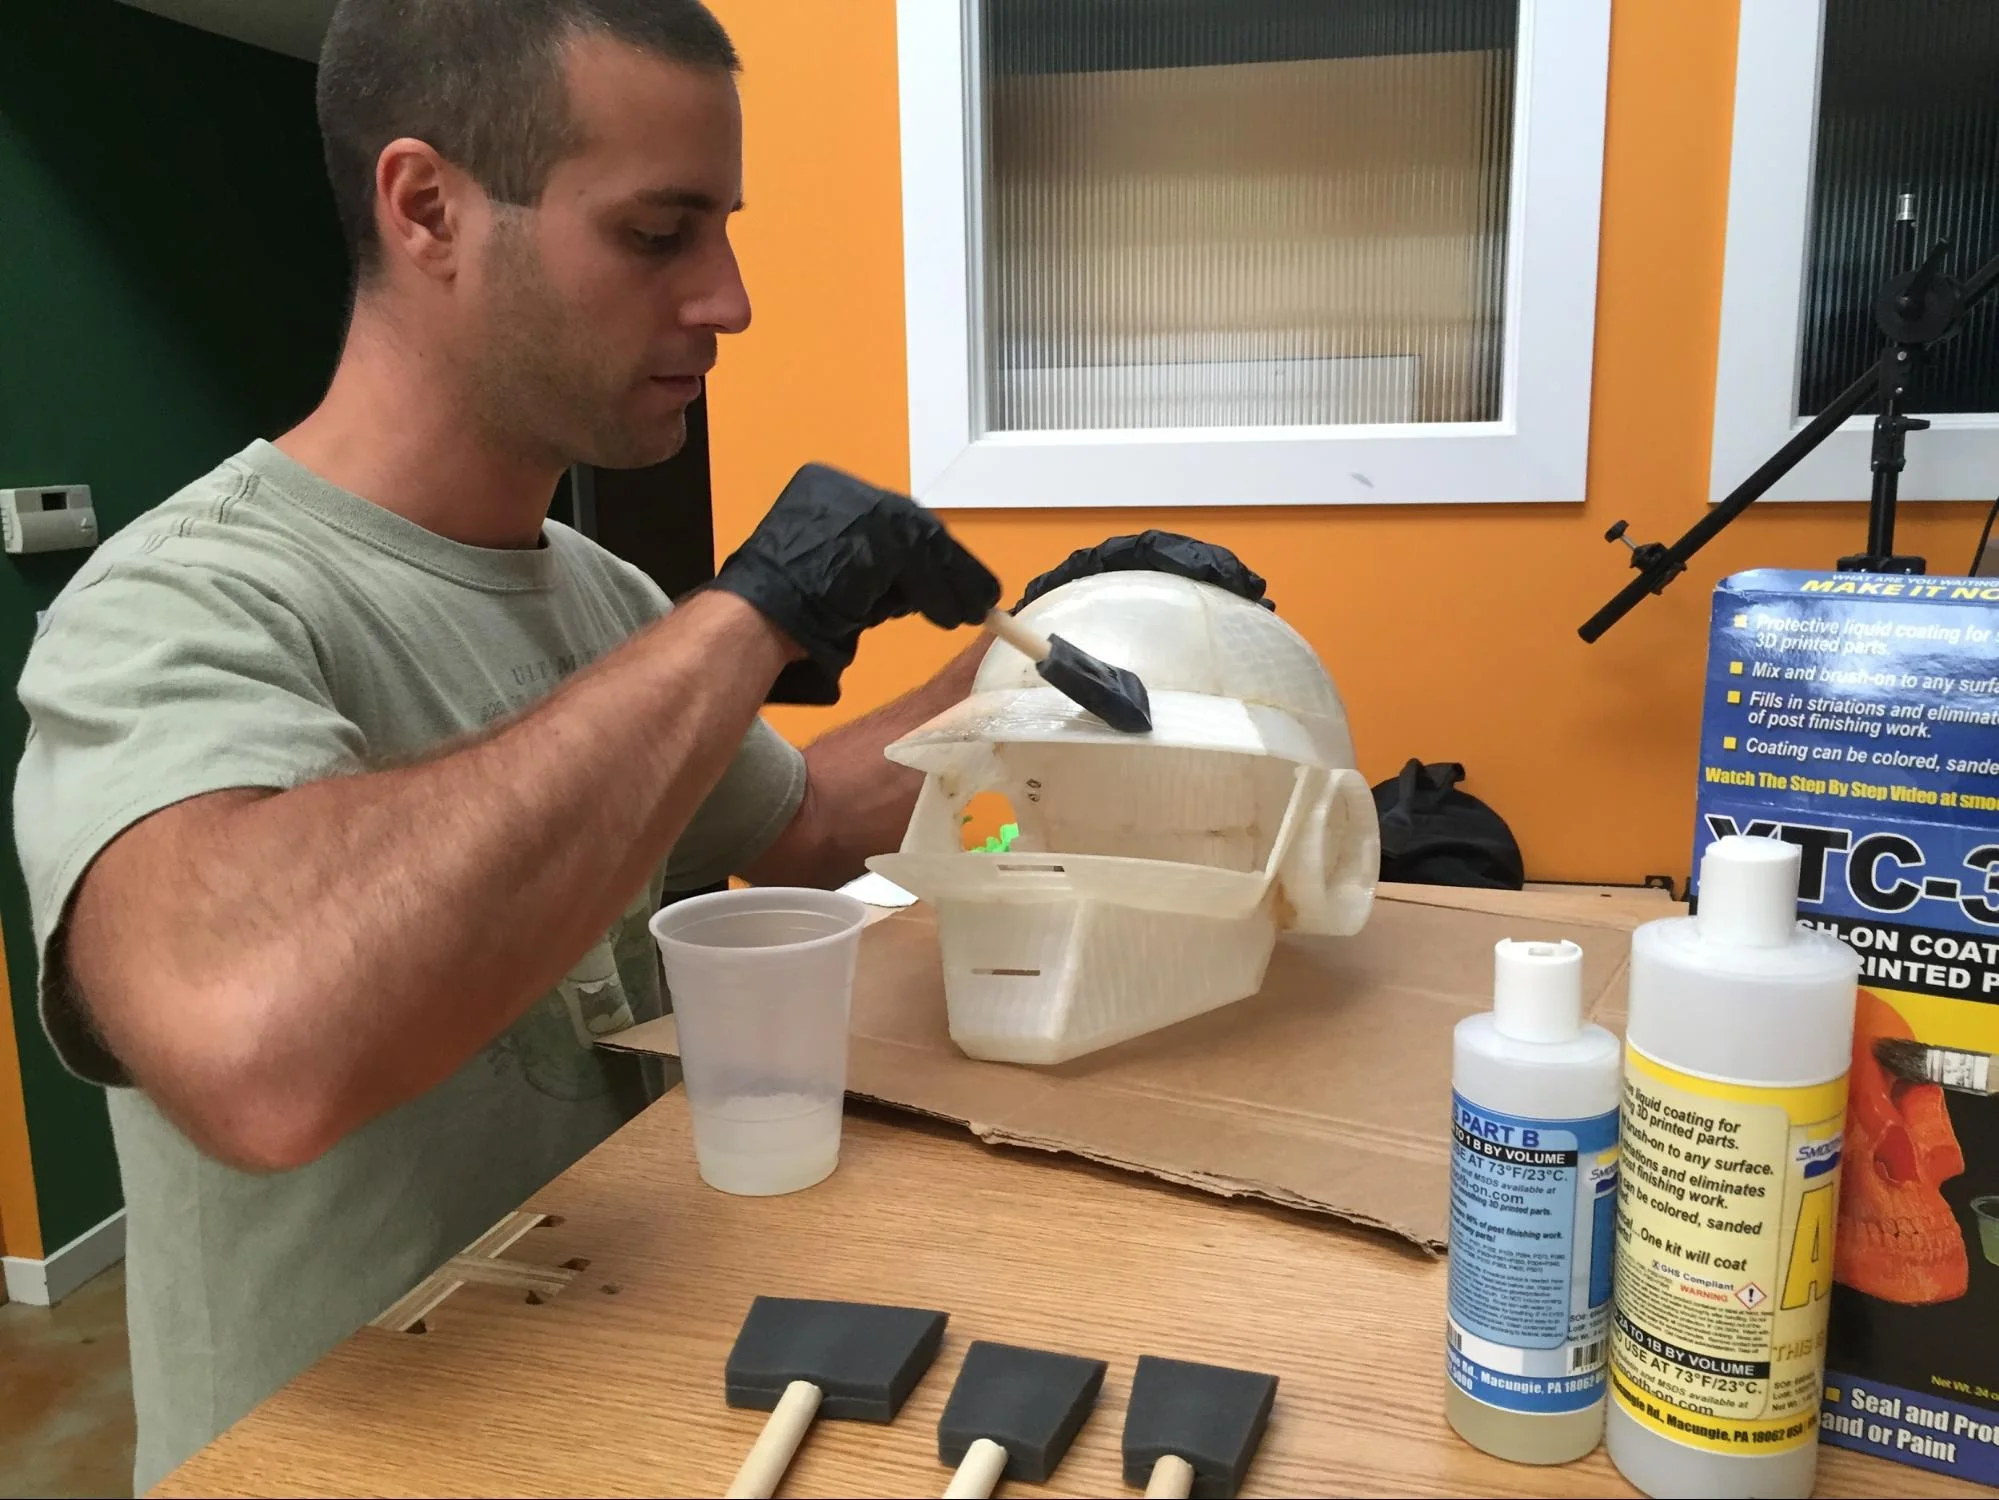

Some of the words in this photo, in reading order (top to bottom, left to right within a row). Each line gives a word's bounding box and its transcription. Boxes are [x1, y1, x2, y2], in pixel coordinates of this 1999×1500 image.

[1800, 580, 1904, 595] MAKE
[1910, 585, 1946, 598] IT
[1755, 614, 1838, 634] Protective
[1844, 620, 1892, 638] liquid
[1895, 625, 1960, 644] coating
[1966, 625, 1989, 642] for
[1755, 632, 1776, 648] 3D
[1781, 634, 1840, 653] printed
[1843, 641, 1890, 655] parts.
[1752, 661, 1781, 679] Mix
[1785, 664, 1815, 681] and
[1820, 669, 1896, 687] brush-on
[1901, 672, 1918, 688] to
[1922, 675, 1954, 694] any
[1749, 690, 1783, 708] Fills
[1787, 692, 1802, 709] in
[1808, 695, 1885, 716] striations
[1891, 700, 1923, 719] and
[1748, 710, 1766, 725] of
[1768, 712, 1804, 729] post
[1809, 715, 1881, 737] finishing
[1886, 722, 1932, 739] work.
[1746, 737, 1809, 762] Coating
[1813, 746, 1842, 761] can
[1847, 747, 1867, 763] be
[1872, 750, 1941, 771] colored,
[1706, 767, 1755, 787] Watch
[1759, 772, 1787, 789] The
[1790, 775, 1825, 795] Step
[1829, 779, 1849, 797] By
[1851, 782, 1887, 800] Step
[1891, 786, 1937, 805] Video
[1940, 790, 1957, 807] at
[1910, 935, 1999, 965] COAT
[1636, 1088, 1661, 1112] liquid
[1663, 1106, 1714, 1131] coating
[1718, 1119, 1741, 1133] for
[1462, 1109, 1515, 1144] PART
[1522, 1130, 1539, 1147] B
[1650, 1116, 1693, 1140] printed
[1696, 1131, 1739, 1150] parts.
[1466, 1136, 1470, 1145] 1
[1473, 1139, 1481, 1150] B
[1484, 1143, 1501, 1156] BY
[1506, 1150, 1565, 1164] VOLUME
[1468, 1154, 1484, 1168] AT
[1627, 1118, 1664, 1152] brush-on
[1668, 1144, 1680, 1158] to
[1684, 1152, 1711, 1169] any
[1715, 1156, 1774, 1176] surface.
[1474, 1172, 1499, 1187] MSDS
[1501, 1183, 1544, 1194] available
[1637, 1165, 1685, 1200] finishing
[1689, 1190, 1728, 1209] work.
[1662, 1168, 1685, 1182] and
[1689, 1174, 1766, 1198] eliminates
[1500, 1204, 1529, 1214] printed
[1530, 1208, 1552, 1216] parts.
[1624, 1178, 1635, 1195] can
[1637, 1187, 1648, 1204] be
[1650, 1197, 1701, 1227] colored,
[1707, 1217, 1763, 1235] sanded
[1487, 1225, 1504, 1234] post
[1506, 1228, 1541, 1240] finishing
[1665, 1240, 1683, 1257] kit
[1685, 1246, 1710, 1265] will
[1714, 1257, 1747, 1272] coat
[1680, 1284, 1728, 1302] WARNING
[1683, 1272, 1734, 1291] Compliant
[1625, 1338, 1647, 1364] USE
[1651, 1358, 1670, 1374] AT
[1630, 1325, 1643, 1342] TO
[1647, 1338, 1661, 1353] 1B
[1665, 1347, 1684, 1361] BY
[1689, 1355, 1755, 1376] VOLUME
[1481, 1371, 1543, 1394] Macungie,
[1548, 1381, 1561, 1393] PA
[1657, 1380, 1686, 1395] MSDS
[1689, 1393, 1735, 1408] available
[1739, 1401, 1749, 1409] at
[1851, 1387, 1900, 1419] Seal
[1905, 1405, 1949, 1432] and
[1667, 1413, 1731, 1441] Macungie,
[1734, 1428, 1749, 1442] PA
[1752, 1426, 1784, 1442] 18062
[1821, 1412, 1864, 1438] and
[1867, 1424, 1893, 1445] or
[1896, 1429, 1956, 1463] Paint
